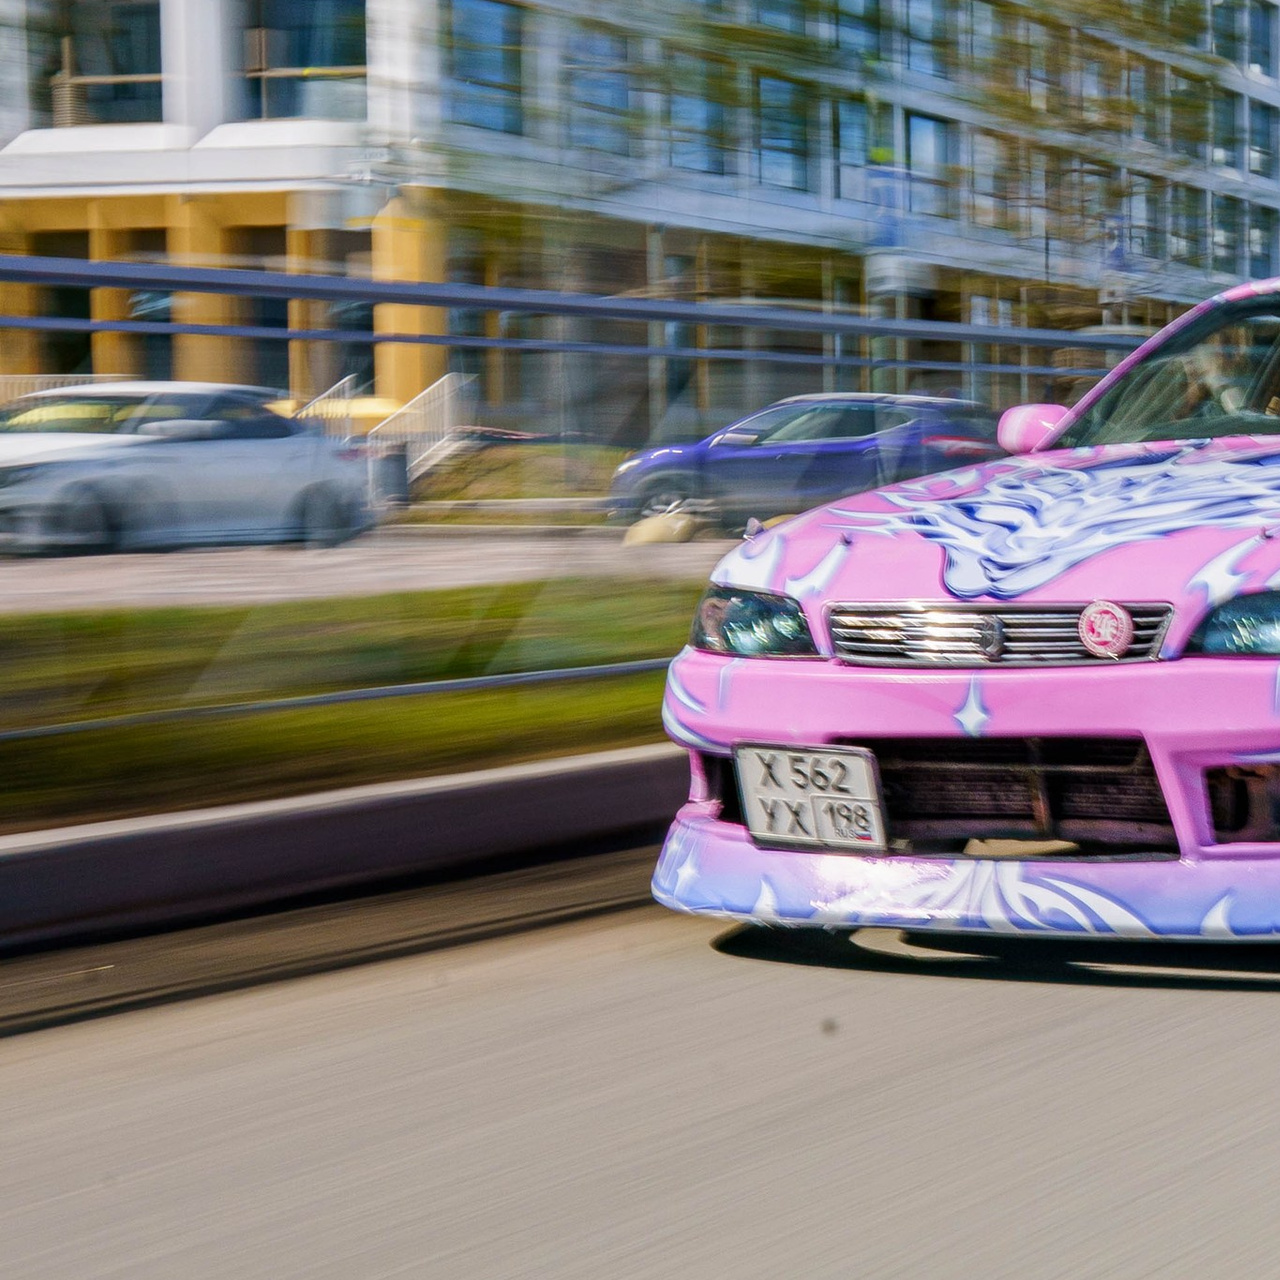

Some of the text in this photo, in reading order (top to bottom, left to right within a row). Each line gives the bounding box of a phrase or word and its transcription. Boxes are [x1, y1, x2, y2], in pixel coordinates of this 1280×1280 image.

[787, 754, 851, 794] 562
[821, 800, 870, 831] 198
[834, 827, 856, 840] RUS
